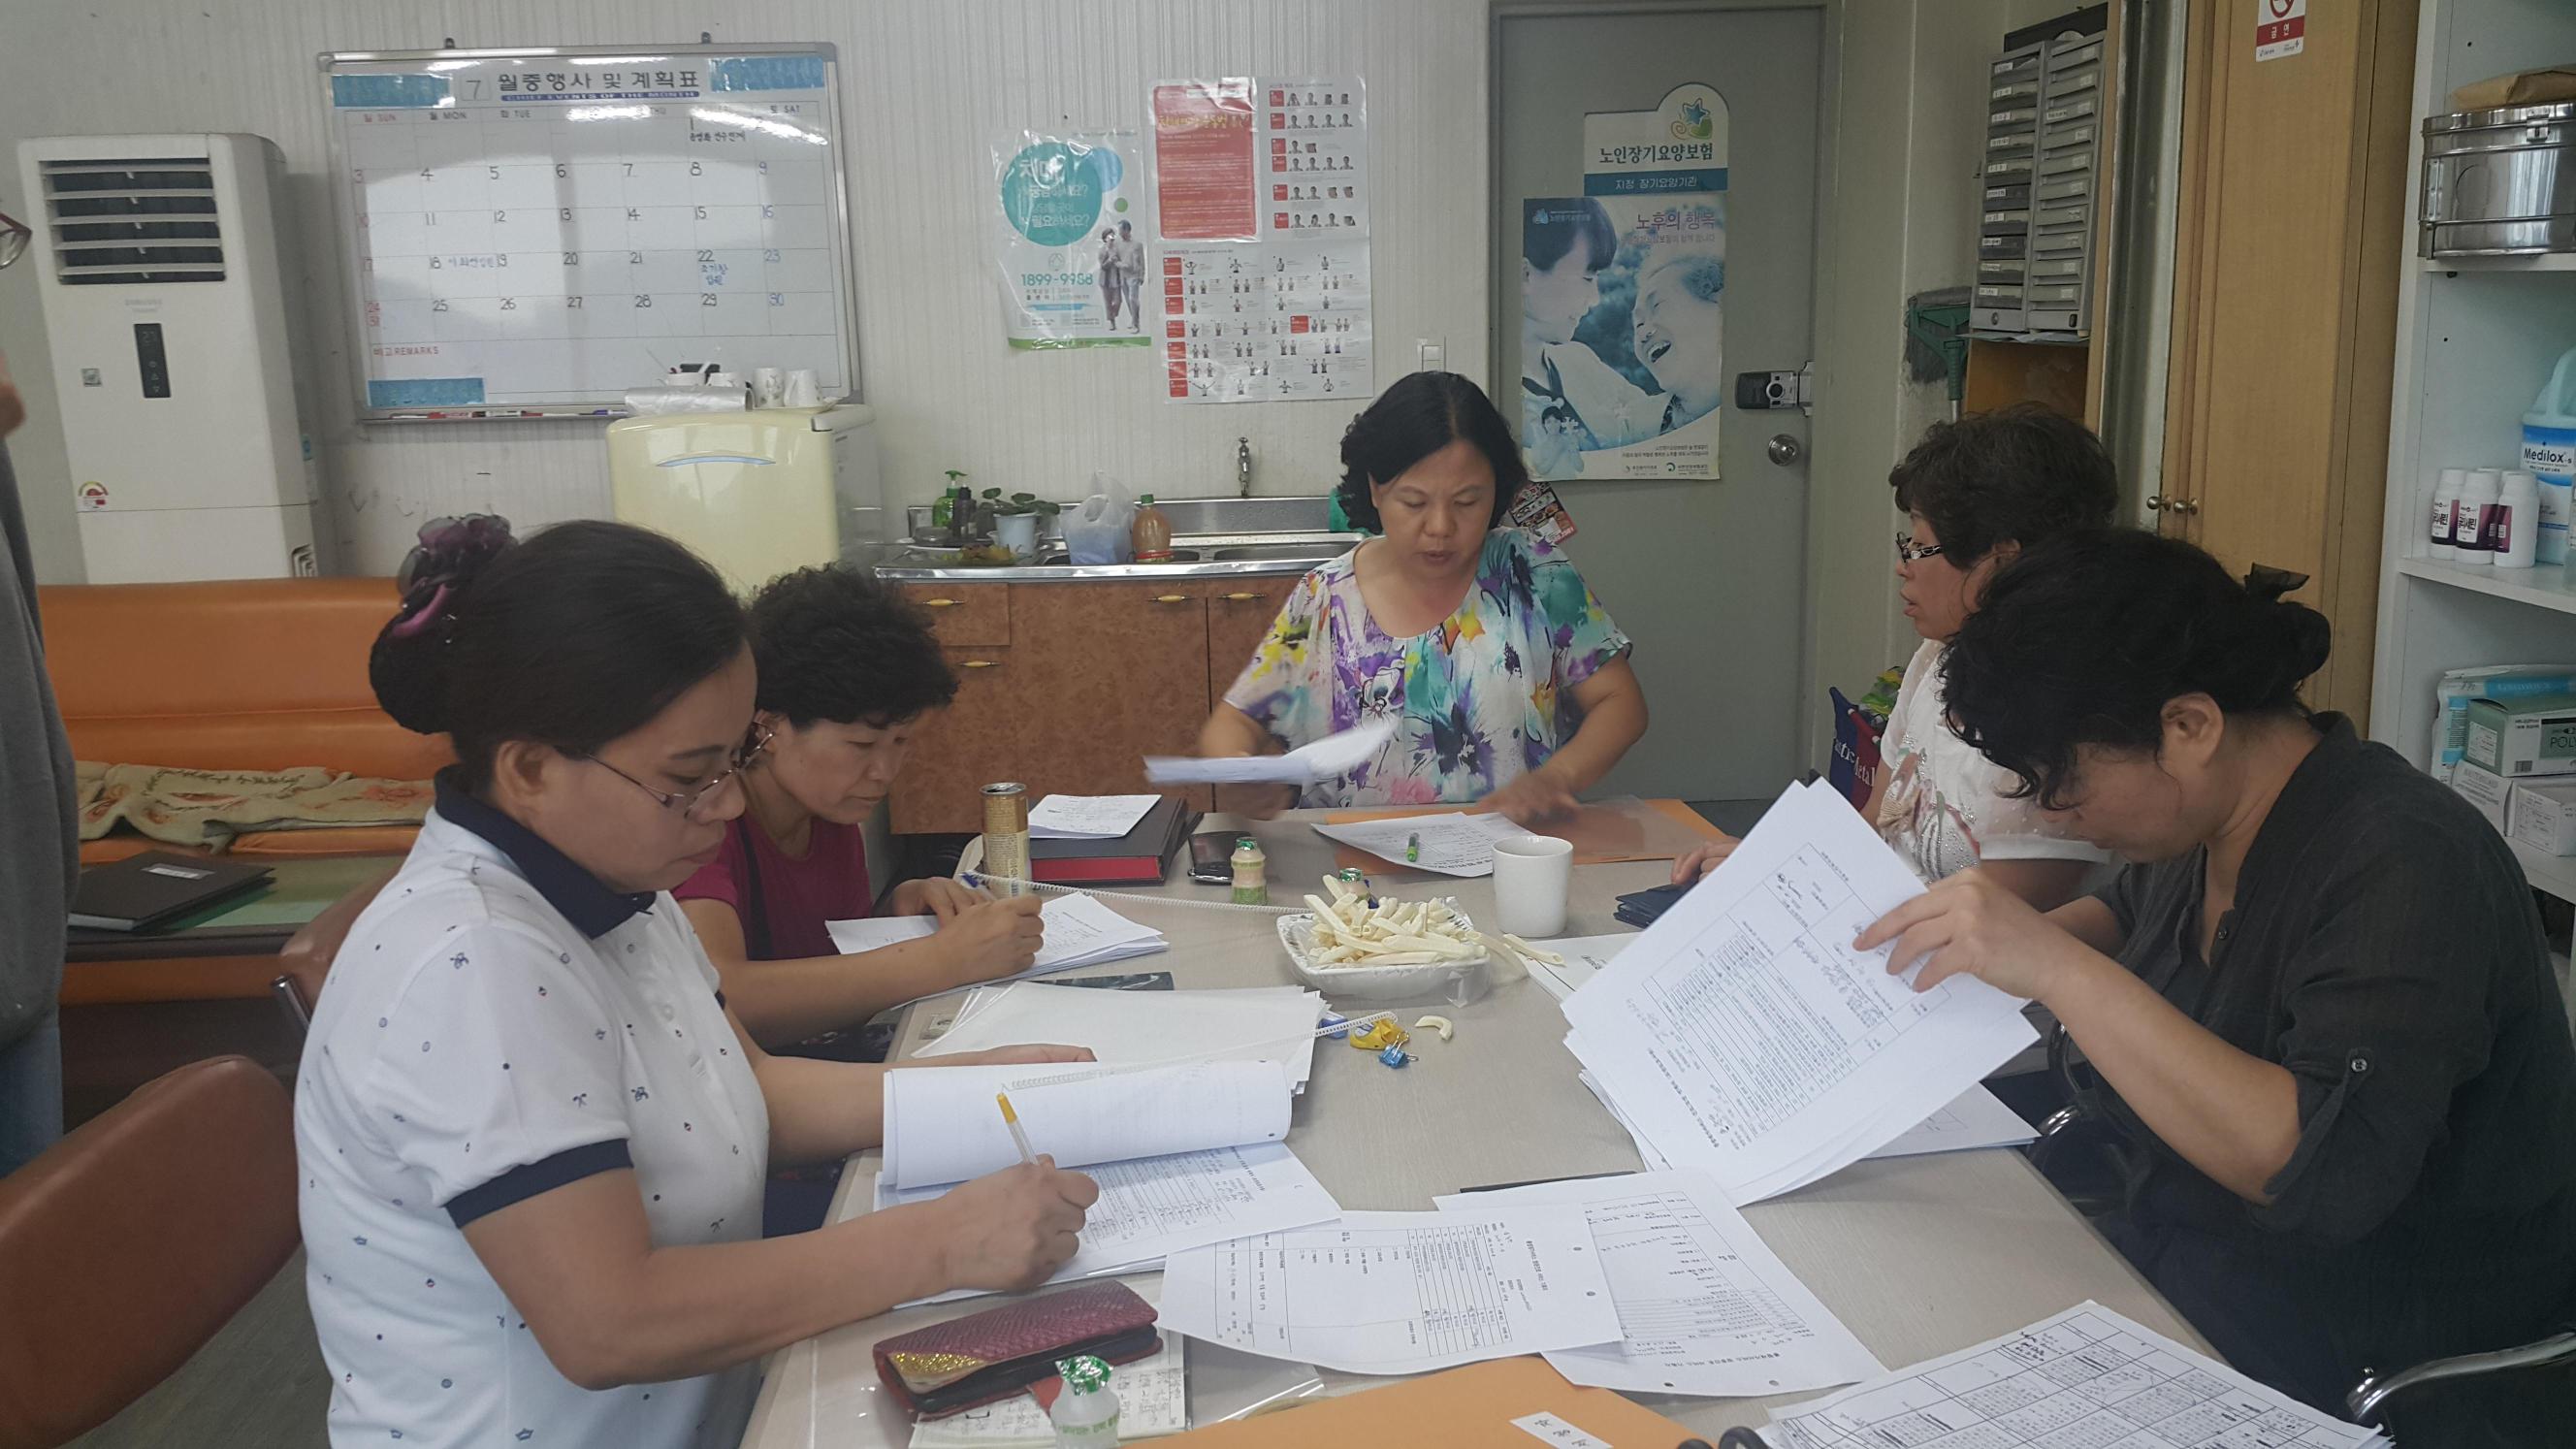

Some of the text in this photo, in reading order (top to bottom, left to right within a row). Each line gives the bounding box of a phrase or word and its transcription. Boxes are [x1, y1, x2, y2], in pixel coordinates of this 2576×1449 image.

[498, 70, 700, 92] 월중행사 및 계획표
[466, 80, 481, 100] 7
[442, 111, 467, 119] MON
[513, 110, 532, 118] TUE
[1599, 143, 1714, 164] 노인장기요양보험
[420, 167, 435, 181] 4
[489, 166, 500, 180] 5
[556, 164, 567, 178] 6
[623, 163, 633, 177] 7
[690, 161, 702, 177] 8
[758, 162, 768, 176] 9
[1615, 176, 1698, 191] 지정 장기요양기관
[426, 212, 436, 226] 11
[493, 209, 506, 223] 12
[560, 208, 572, 221] 13
[628, 209, 640, 222] 14
[693, 206, 707, 220] 15
[761, 206, 774, 219] 16
[1635, 210, 1716, 231] 노후의 행복
[564, 251, 578, 266] 20
[629, 251, 643, 265] 21
[696, 248, 715, 262] 22
[763, 248, 782, 263] 23
[429, 256, 442, 270] 18
[433, 300, 448, 311] 25
[499, 298, 517, 310] 26
[566, 297, 583, 309] 27
[634, 295, 652, 308] 28
[701, 293, 718, 306] 29
[768, 293, 785, 306] 30
[394, 346, 439, 356] REMARKS
